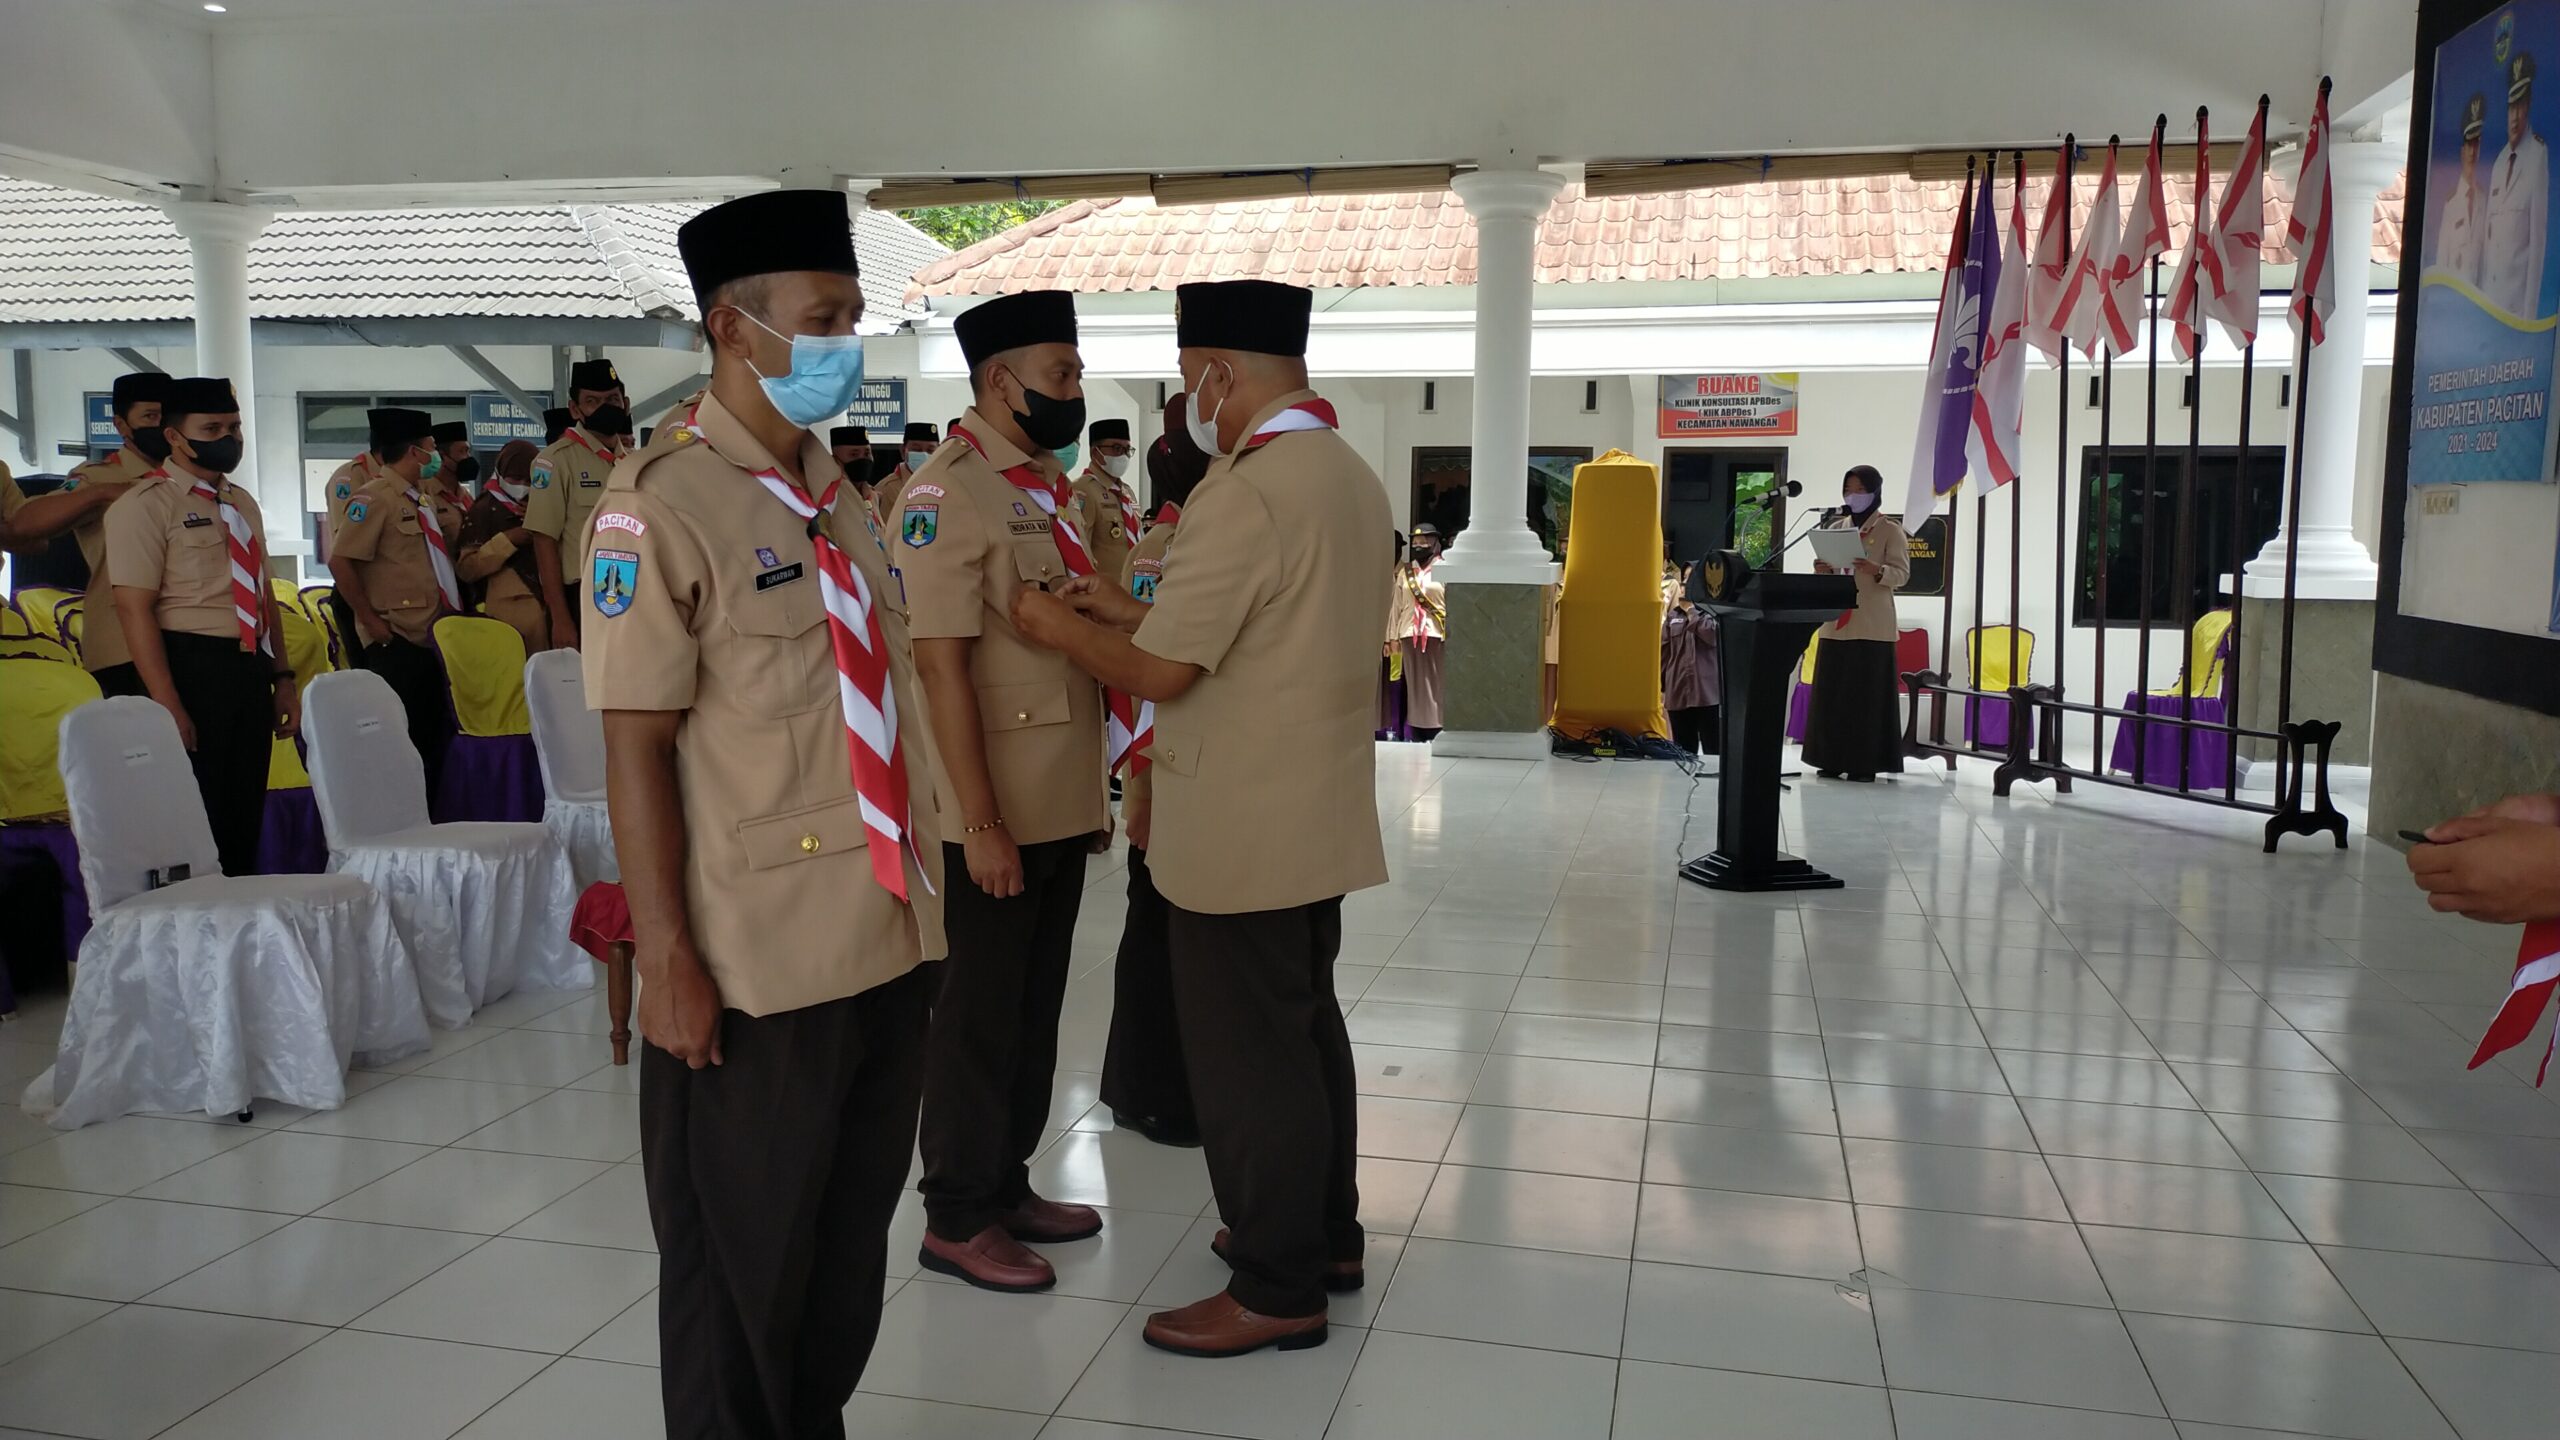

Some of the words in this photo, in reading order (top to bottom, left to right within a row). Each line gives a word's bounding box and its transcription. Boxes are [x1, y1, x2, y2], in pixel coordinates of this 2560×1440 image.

[2428, 369, 2486, 393] PEMERINTAH
[2488, 358, 2535, 384] DAERAH
[861, 384, 891, 398] TUNGGU
[1696, 375, 1760, 396] RUANG
[489, 403, 510, 418] RUANG
[847, 401, 872, 413] ANAN
[873, 401, 900, 413] UMUM
[1674, 399, 1701, 408] KLINIK
[1701, 398, 1749, 408] KONSULTASI
[1750, 397, 1781, 406] APBDes
[2416, 400, 2484, 430] KABUPATEN
[2486, 391, 2545, 423] PACITAN
[473, 422, 511, 437] SEKRETARIAT
[512, 423, 547, 438] KECAMATA
[1677, 420, 1728, 429] KECAMATAN
[1729, 418, 1778, 428] NAWANGAN
[2447, 433, 2468, 453] 2021
[2475, 431, 2498, 453] 2024
[598, 514, 640, 533] PACITAN
